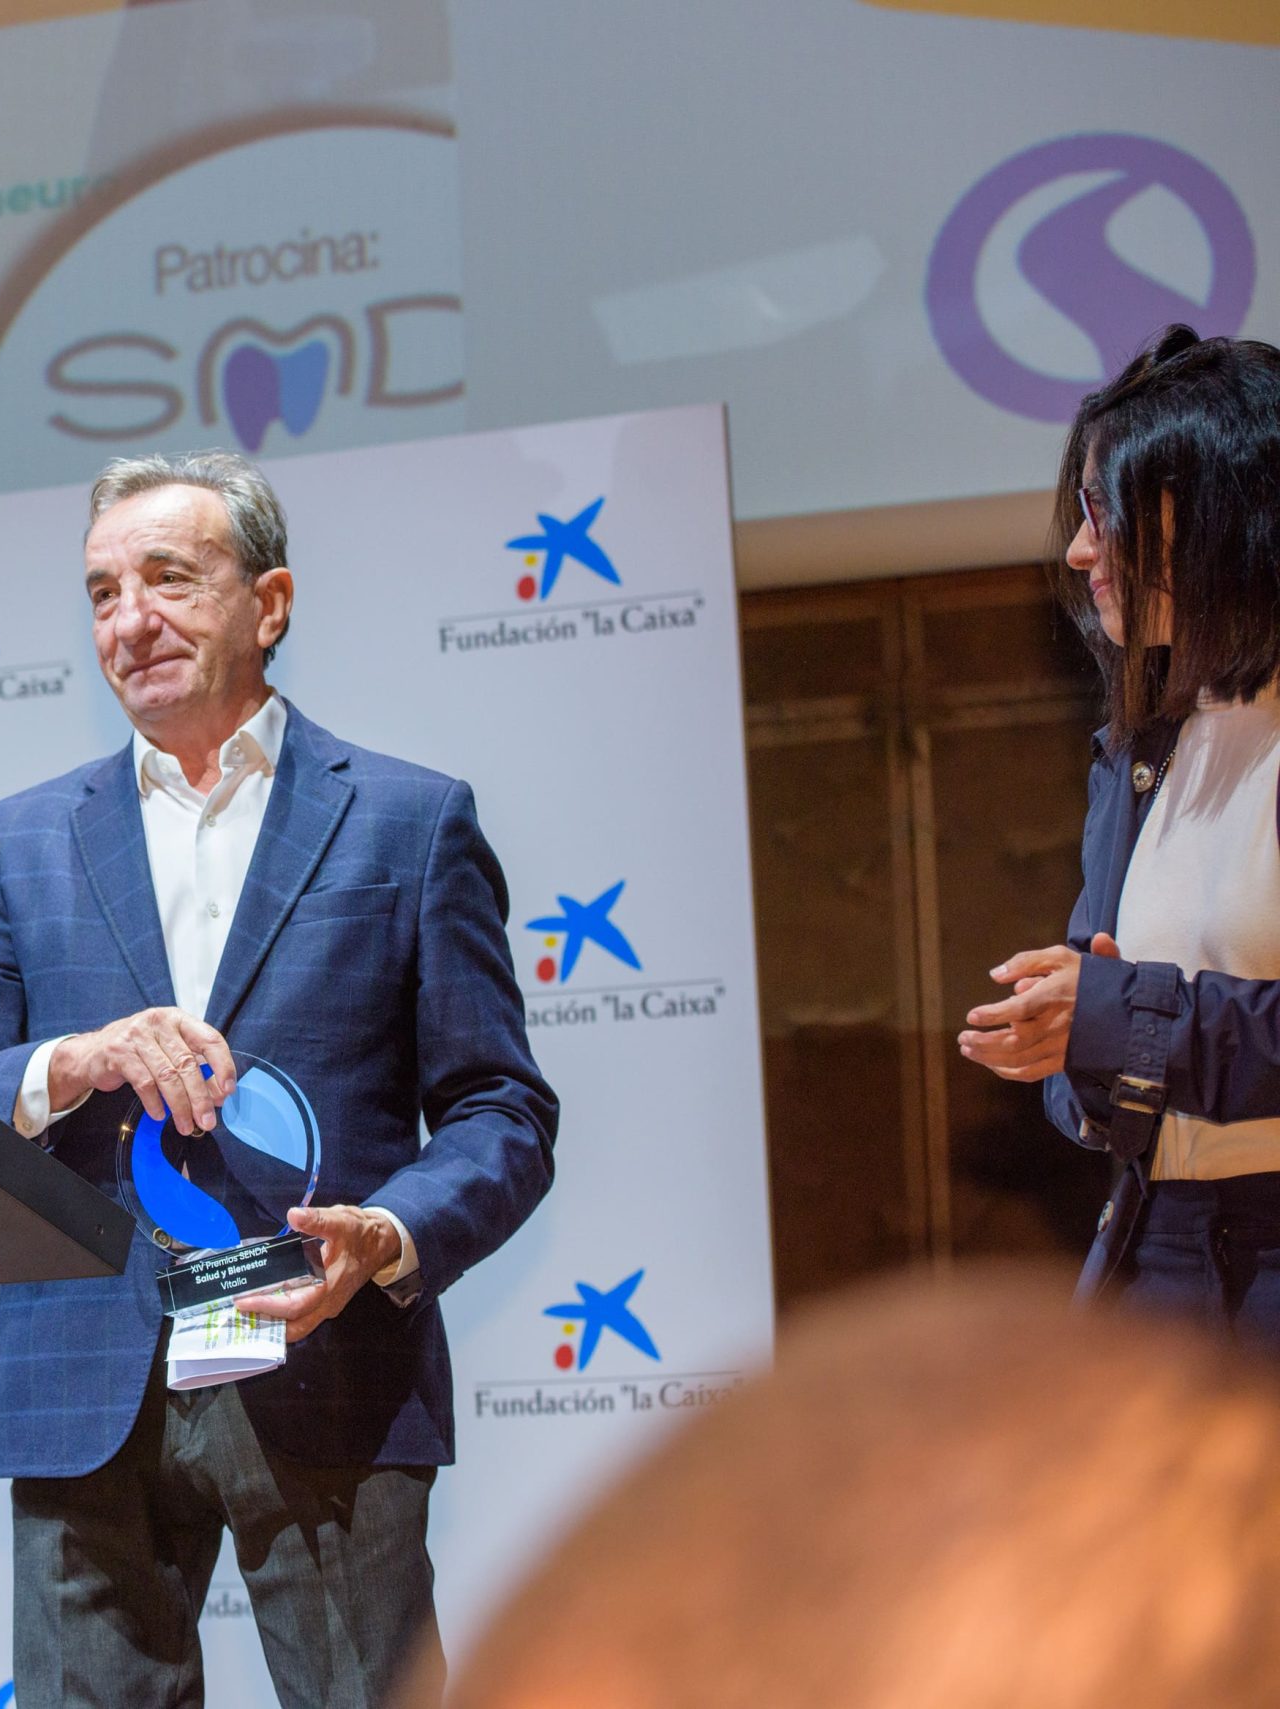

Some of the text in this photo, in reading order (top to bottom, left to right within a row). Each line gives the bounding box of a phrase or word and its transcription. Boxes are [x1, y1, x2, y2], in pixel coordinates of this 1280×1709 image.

[154, 226, 381, 297] Patrocina:
[438, 597, 705, 653] Fundación "la Caixa"
[601, 995, 635, 1022] "la
[640, 984, 725, 1020] Caixa"
[195, 1270, 220, 1285] Salud
[228, 1258, 268, 1276] Bienestar
[205, 1255, 238, 1272] Premios
[239, 1244, 269, 1262] SENDA
[474, 1384, 615, 1418] Fundación
